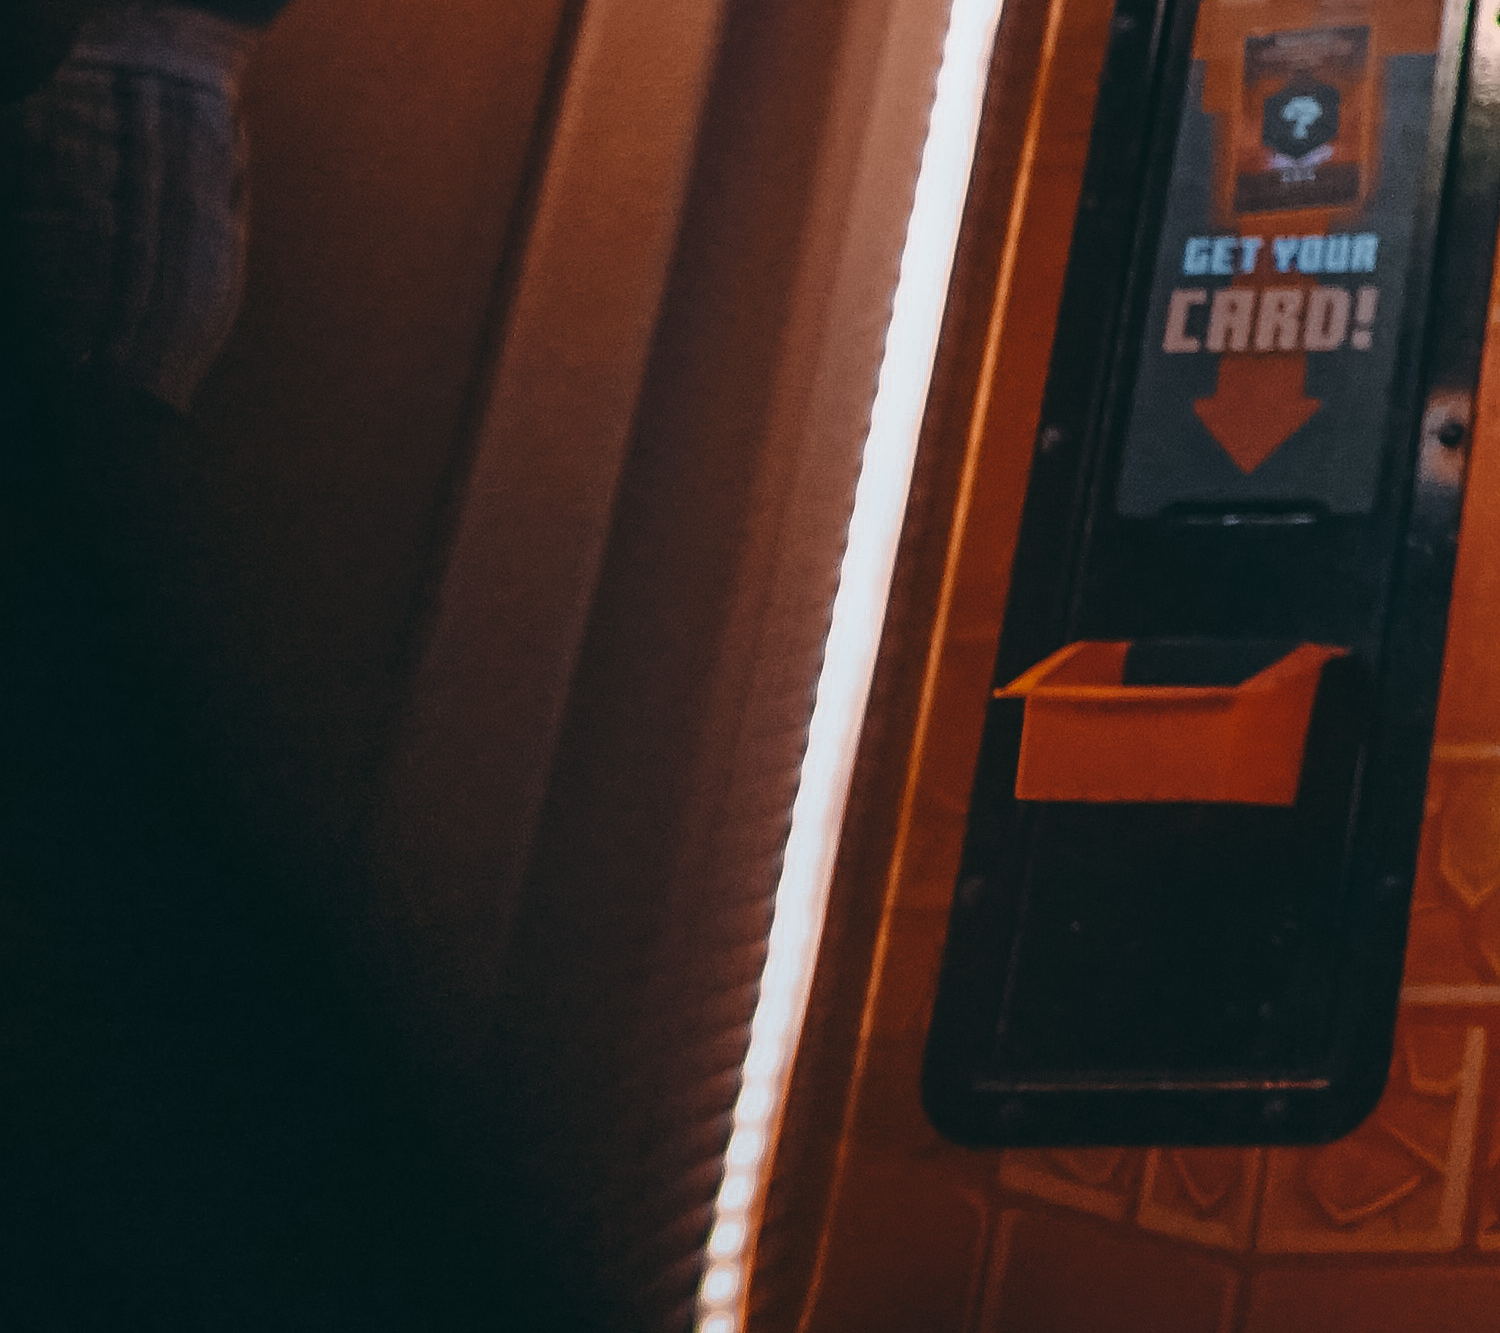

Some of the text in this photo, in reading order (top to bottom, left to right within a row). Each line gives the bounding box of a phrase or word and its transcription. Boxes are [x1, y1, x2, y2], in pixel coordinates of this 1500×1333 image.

[1183, 233, 1379, 275] GET YOUR
[1162, 286, 1379, 353] CARD!
